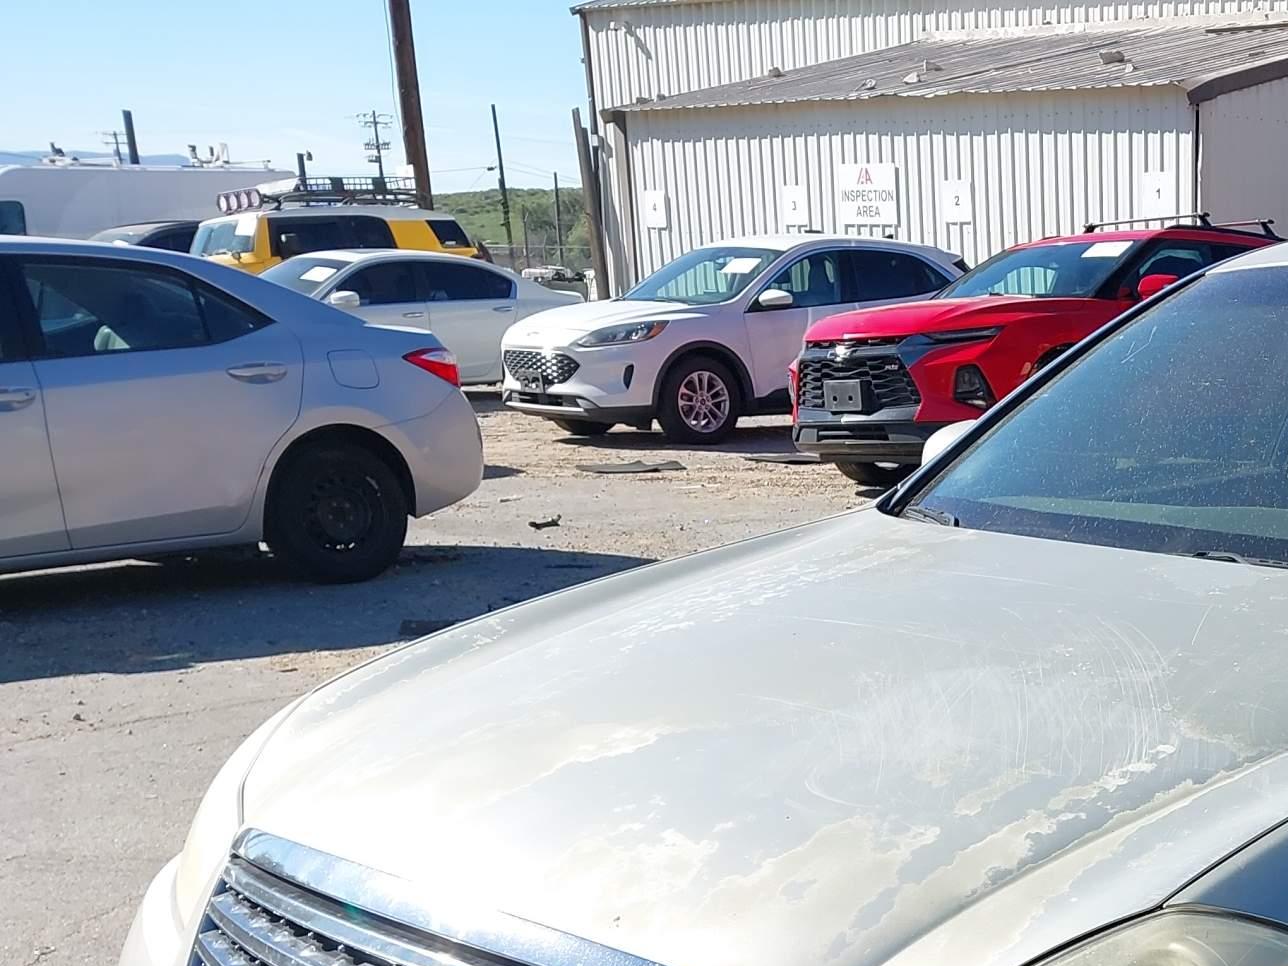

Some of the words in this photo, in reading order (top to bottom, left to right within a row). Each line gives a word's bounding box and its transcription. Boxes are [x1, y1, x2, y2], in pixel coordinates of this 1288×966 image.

[841, 189, 894, 203] INSPECTION
[954, 195, 961, 207] 2
[856, 205, 881, 218] AREA
